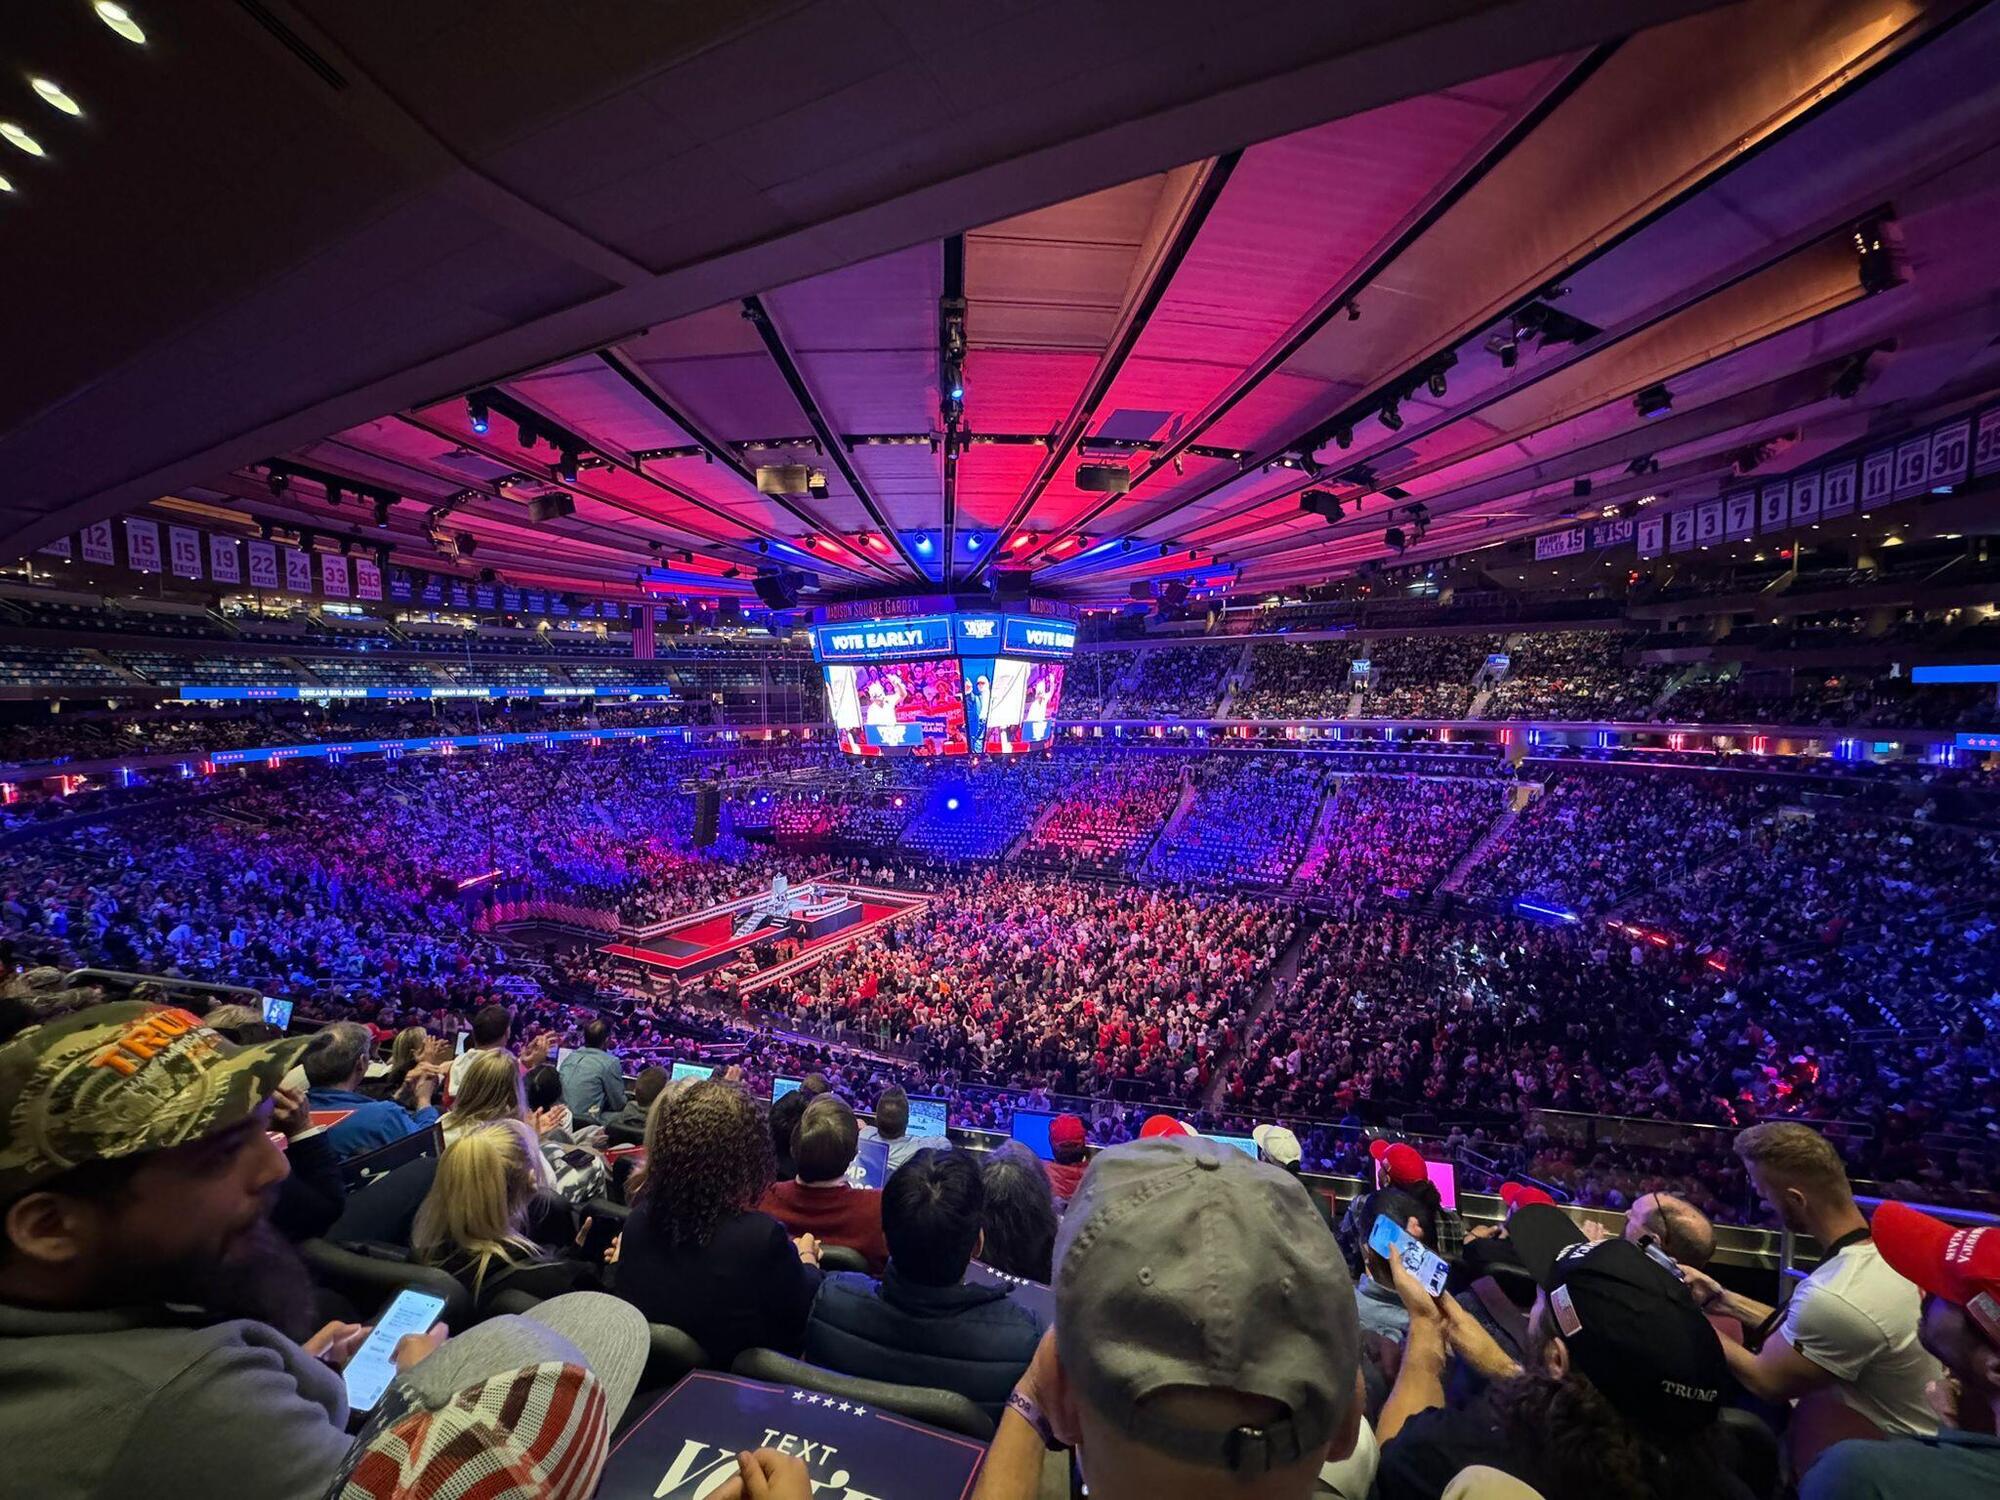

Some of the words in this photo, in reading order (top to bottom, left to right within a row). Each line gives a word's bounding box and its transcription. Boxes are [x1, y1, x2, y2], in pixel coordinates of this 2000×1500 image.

[1933, 440, 1965, 474] 30
[1898, 454, 1925, 485] 19
[1868, 466, 1886, 496] 11
[1800, 488, 1812, 512] 9
[1830, 478, 1848, 505] 11
[1735, 506, 1747, 529] 7
[1769, 497, 1780, 520] 9
[1676, 521, 1687, 541] 2
[1704, 515, 1715, 534] 3
[86, 526, 107, 547] 12
[133, 534, 155, 556] 15
[1567, 527, 1583, 548] 15
[1646, 528, 1654, 548] 1
[175, 542, 196, 562] 15
[215, 549, 234, 567] 19
[252, 556, 274, 574] 22
[288, 561, 309, 579] 24
[325, 567, 346, 583] 33
[360, 572, 380, 587] 613
[854, 600, 883, 618] SQUARE
[885, 599, 919, 614] GARDEN
[832, 634, 865, 650] VOTE
[866, 630, 924, 648] EARLY!
[1026, 630, 1055, 646] VOTE
[1661, 1380, 1718, 1402] TRUMP
[760, 1428, 838, 1466] TEXT
